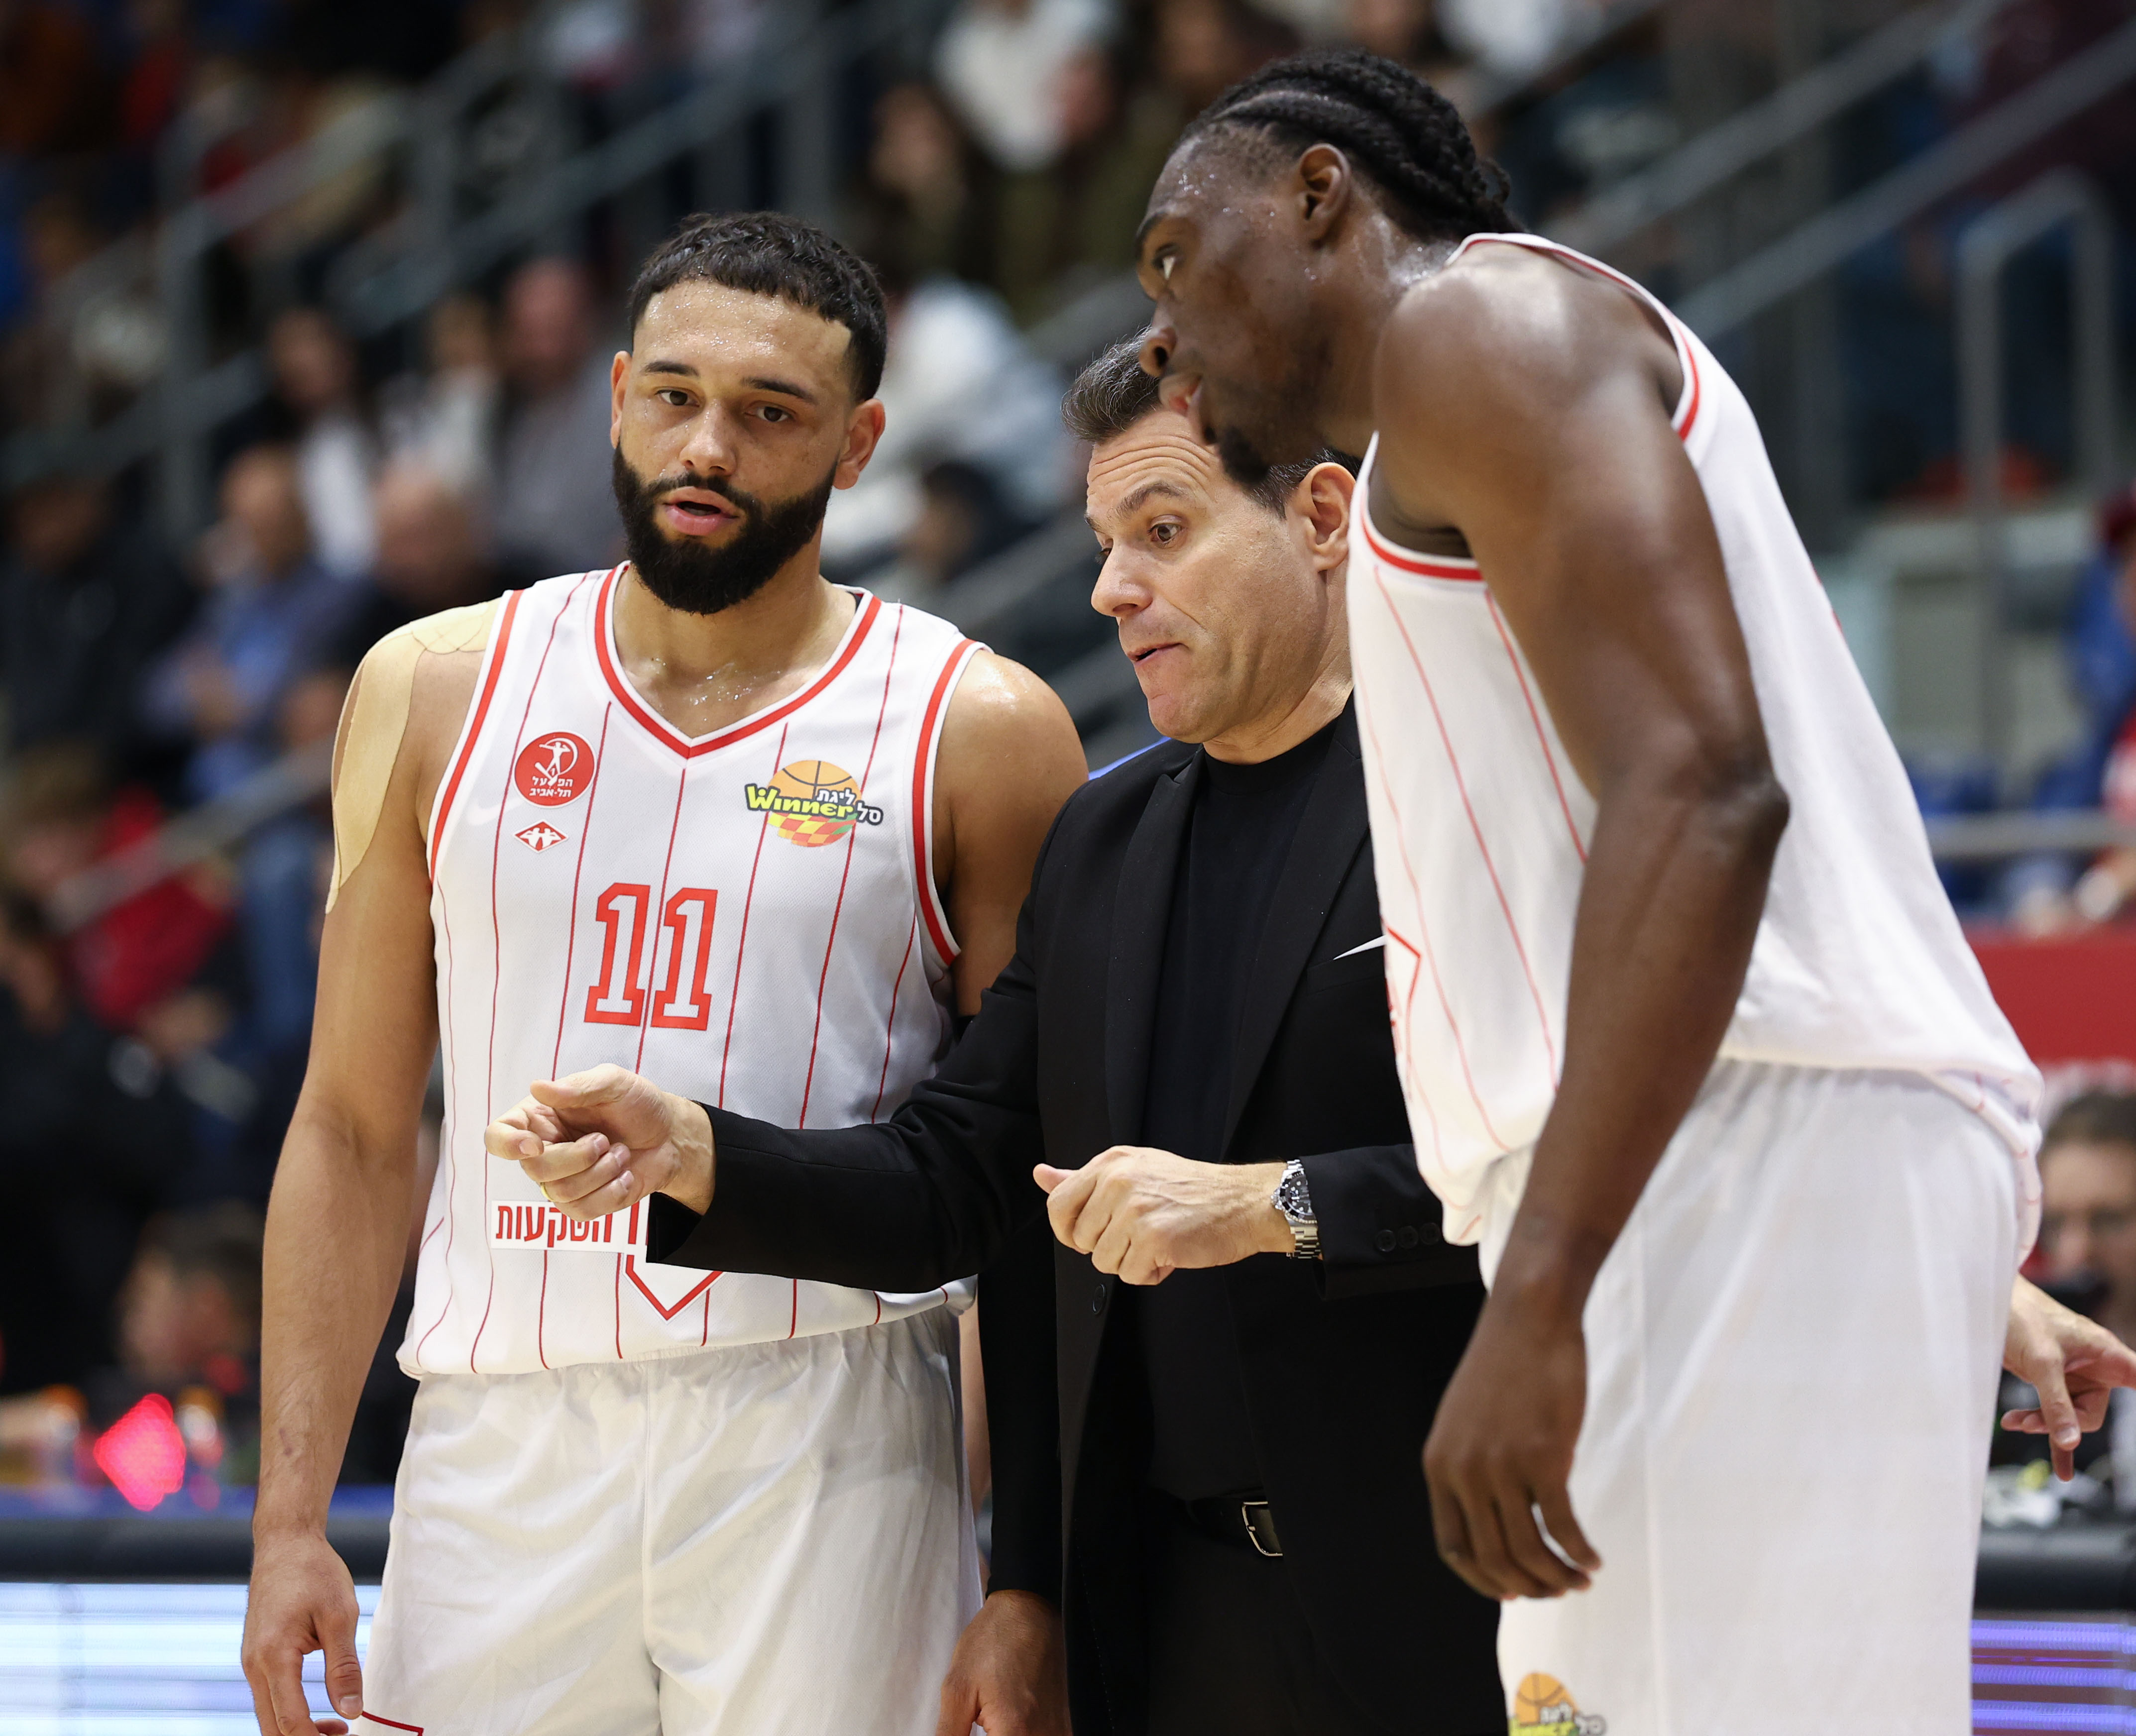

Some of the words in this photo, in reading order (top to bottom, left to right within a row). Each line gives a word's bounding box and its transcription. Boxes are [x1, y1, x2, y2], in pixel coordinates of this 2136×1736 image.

[746, 784, 854, 819] Winner
[816, 788, 855, 805] ליגת
[857, 802, 882, 824] סל
[583, 882, 718, 1031] 11
